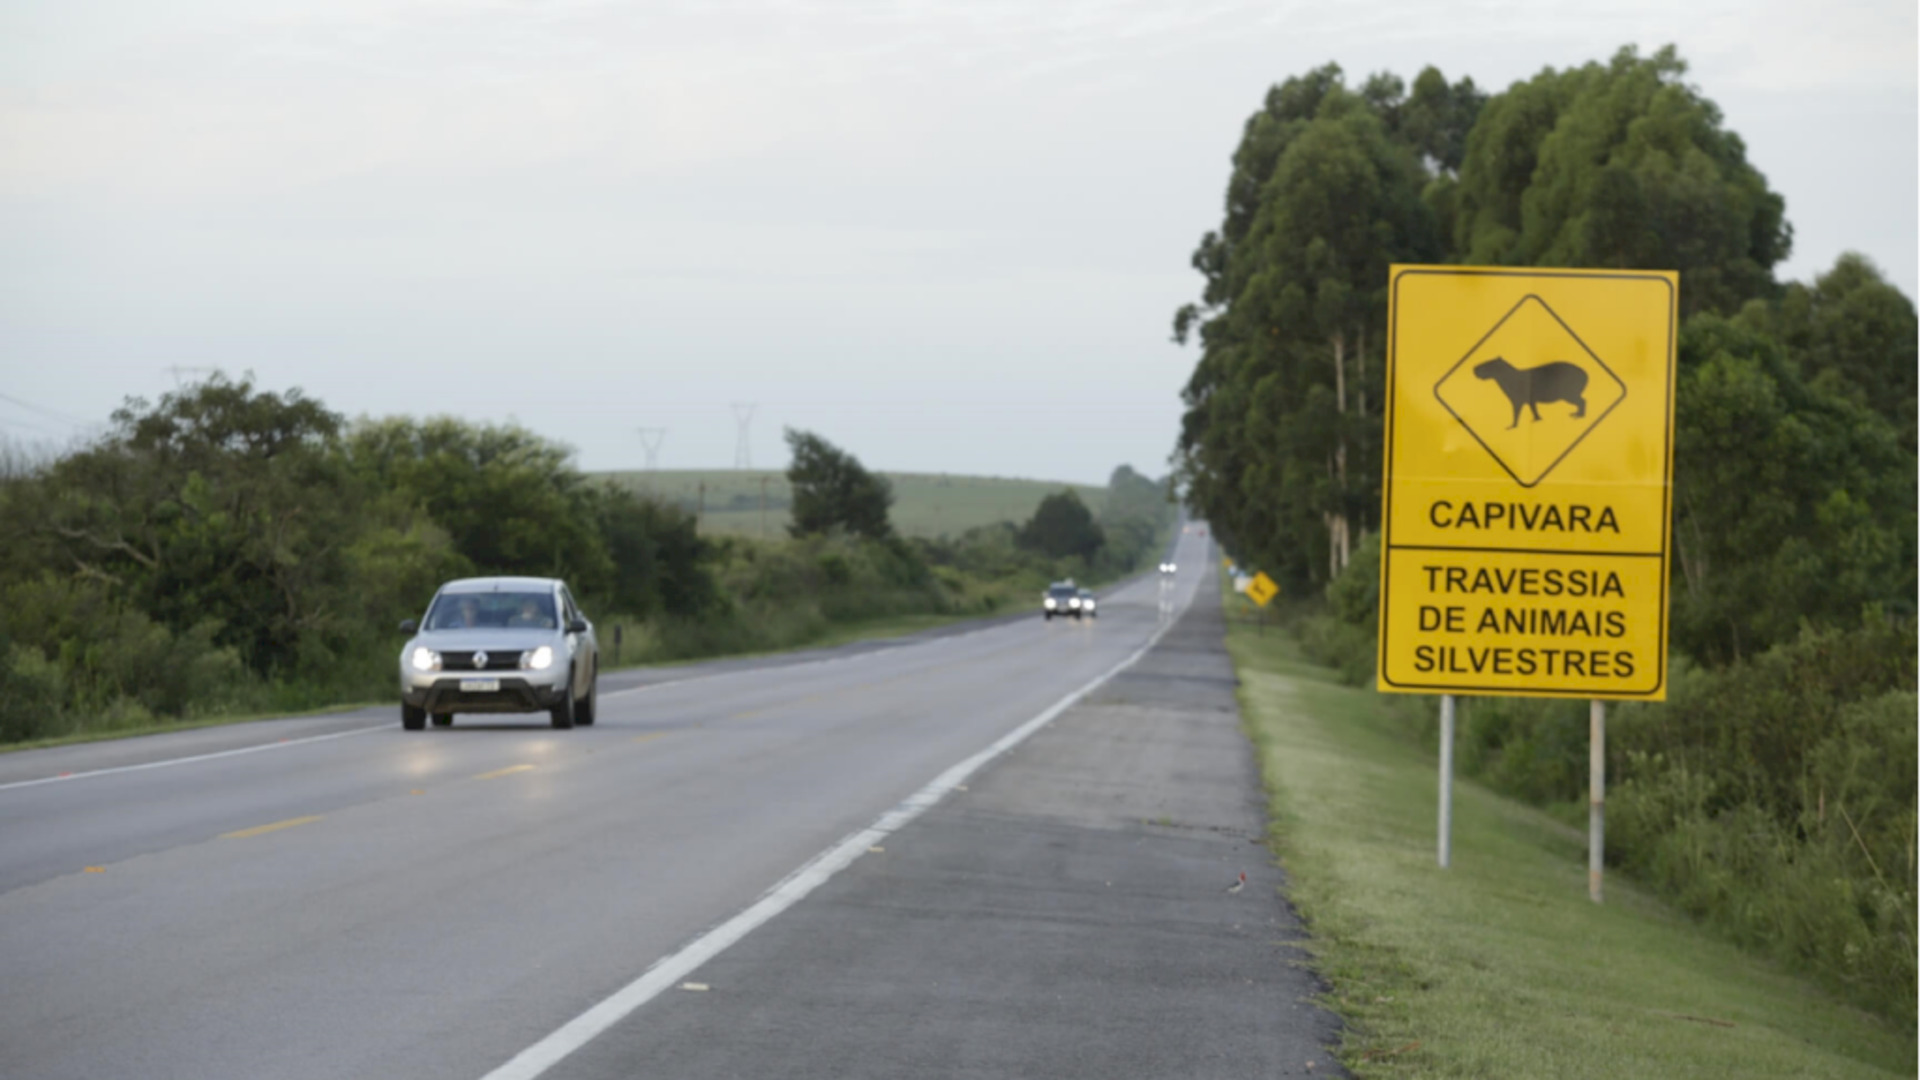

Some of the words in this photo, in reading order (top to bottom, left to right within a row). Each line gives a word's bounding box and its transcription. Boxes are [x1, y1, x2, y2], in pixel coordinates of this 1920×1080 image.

[1429, 500, 1620, 533] CAPIVARA
[1422, 566, 1625, 598] TRAVESSIA
[1419, 605, 1465, 633] DE
[1476, 607, 1626, 638] ANIMAIS
[1414, 645, 1635, 678] SILVESTRES
